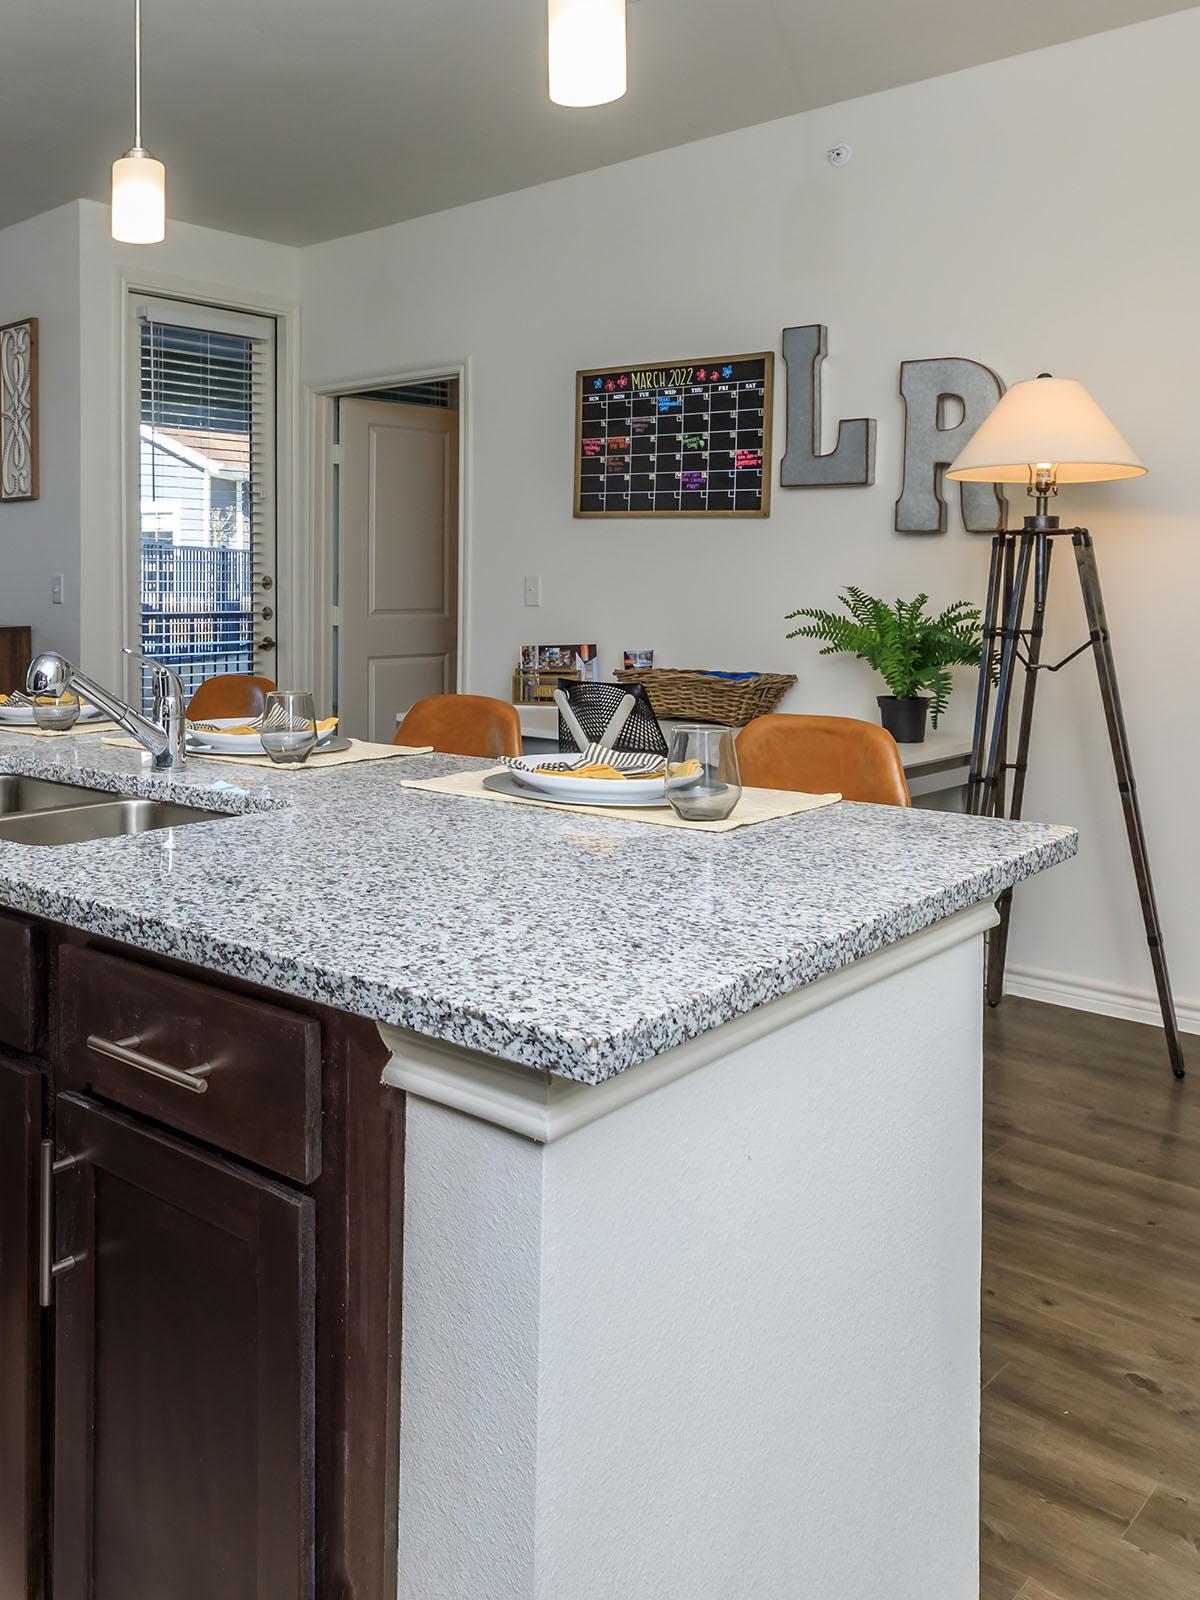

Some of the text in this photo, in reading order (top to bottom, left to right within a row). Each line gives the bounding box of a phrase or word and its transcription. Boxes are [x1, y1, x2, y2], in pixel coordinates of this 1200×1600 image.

[631, 367, 694, 391] MARCH 2022
[780, 324, 877, 487] L
[895, 357, 1009, 533] R
